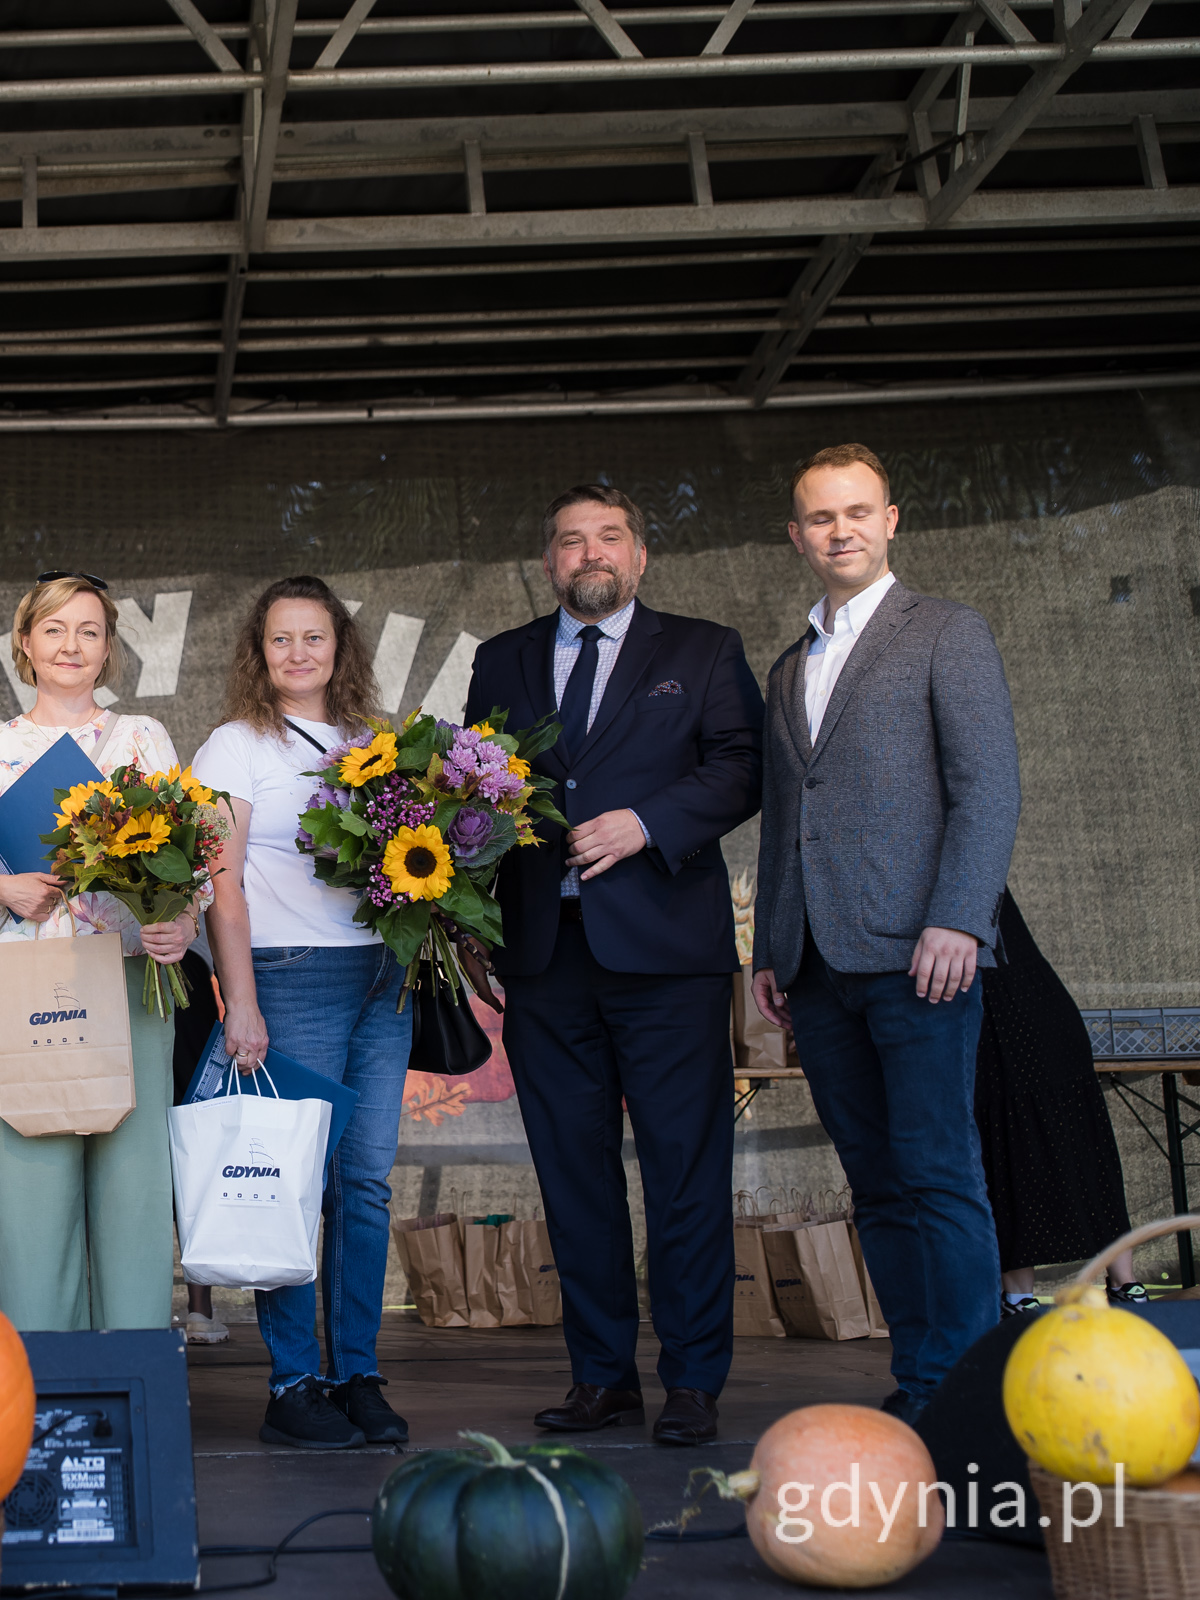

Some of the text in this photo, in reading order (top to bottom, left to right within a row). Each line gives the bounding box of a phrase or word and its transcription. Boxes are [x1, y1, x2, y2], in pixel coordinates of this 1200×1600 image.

[29, 1009, 87, 1026] GDYNIA
[222, 1165, 281, 1178] GDYNIA
[775, 1278, 802, 1288] GDYNIA
[61, 1455, 106, 1468] ALTO
[62, 1481, 106, 1491] TOURMAX
